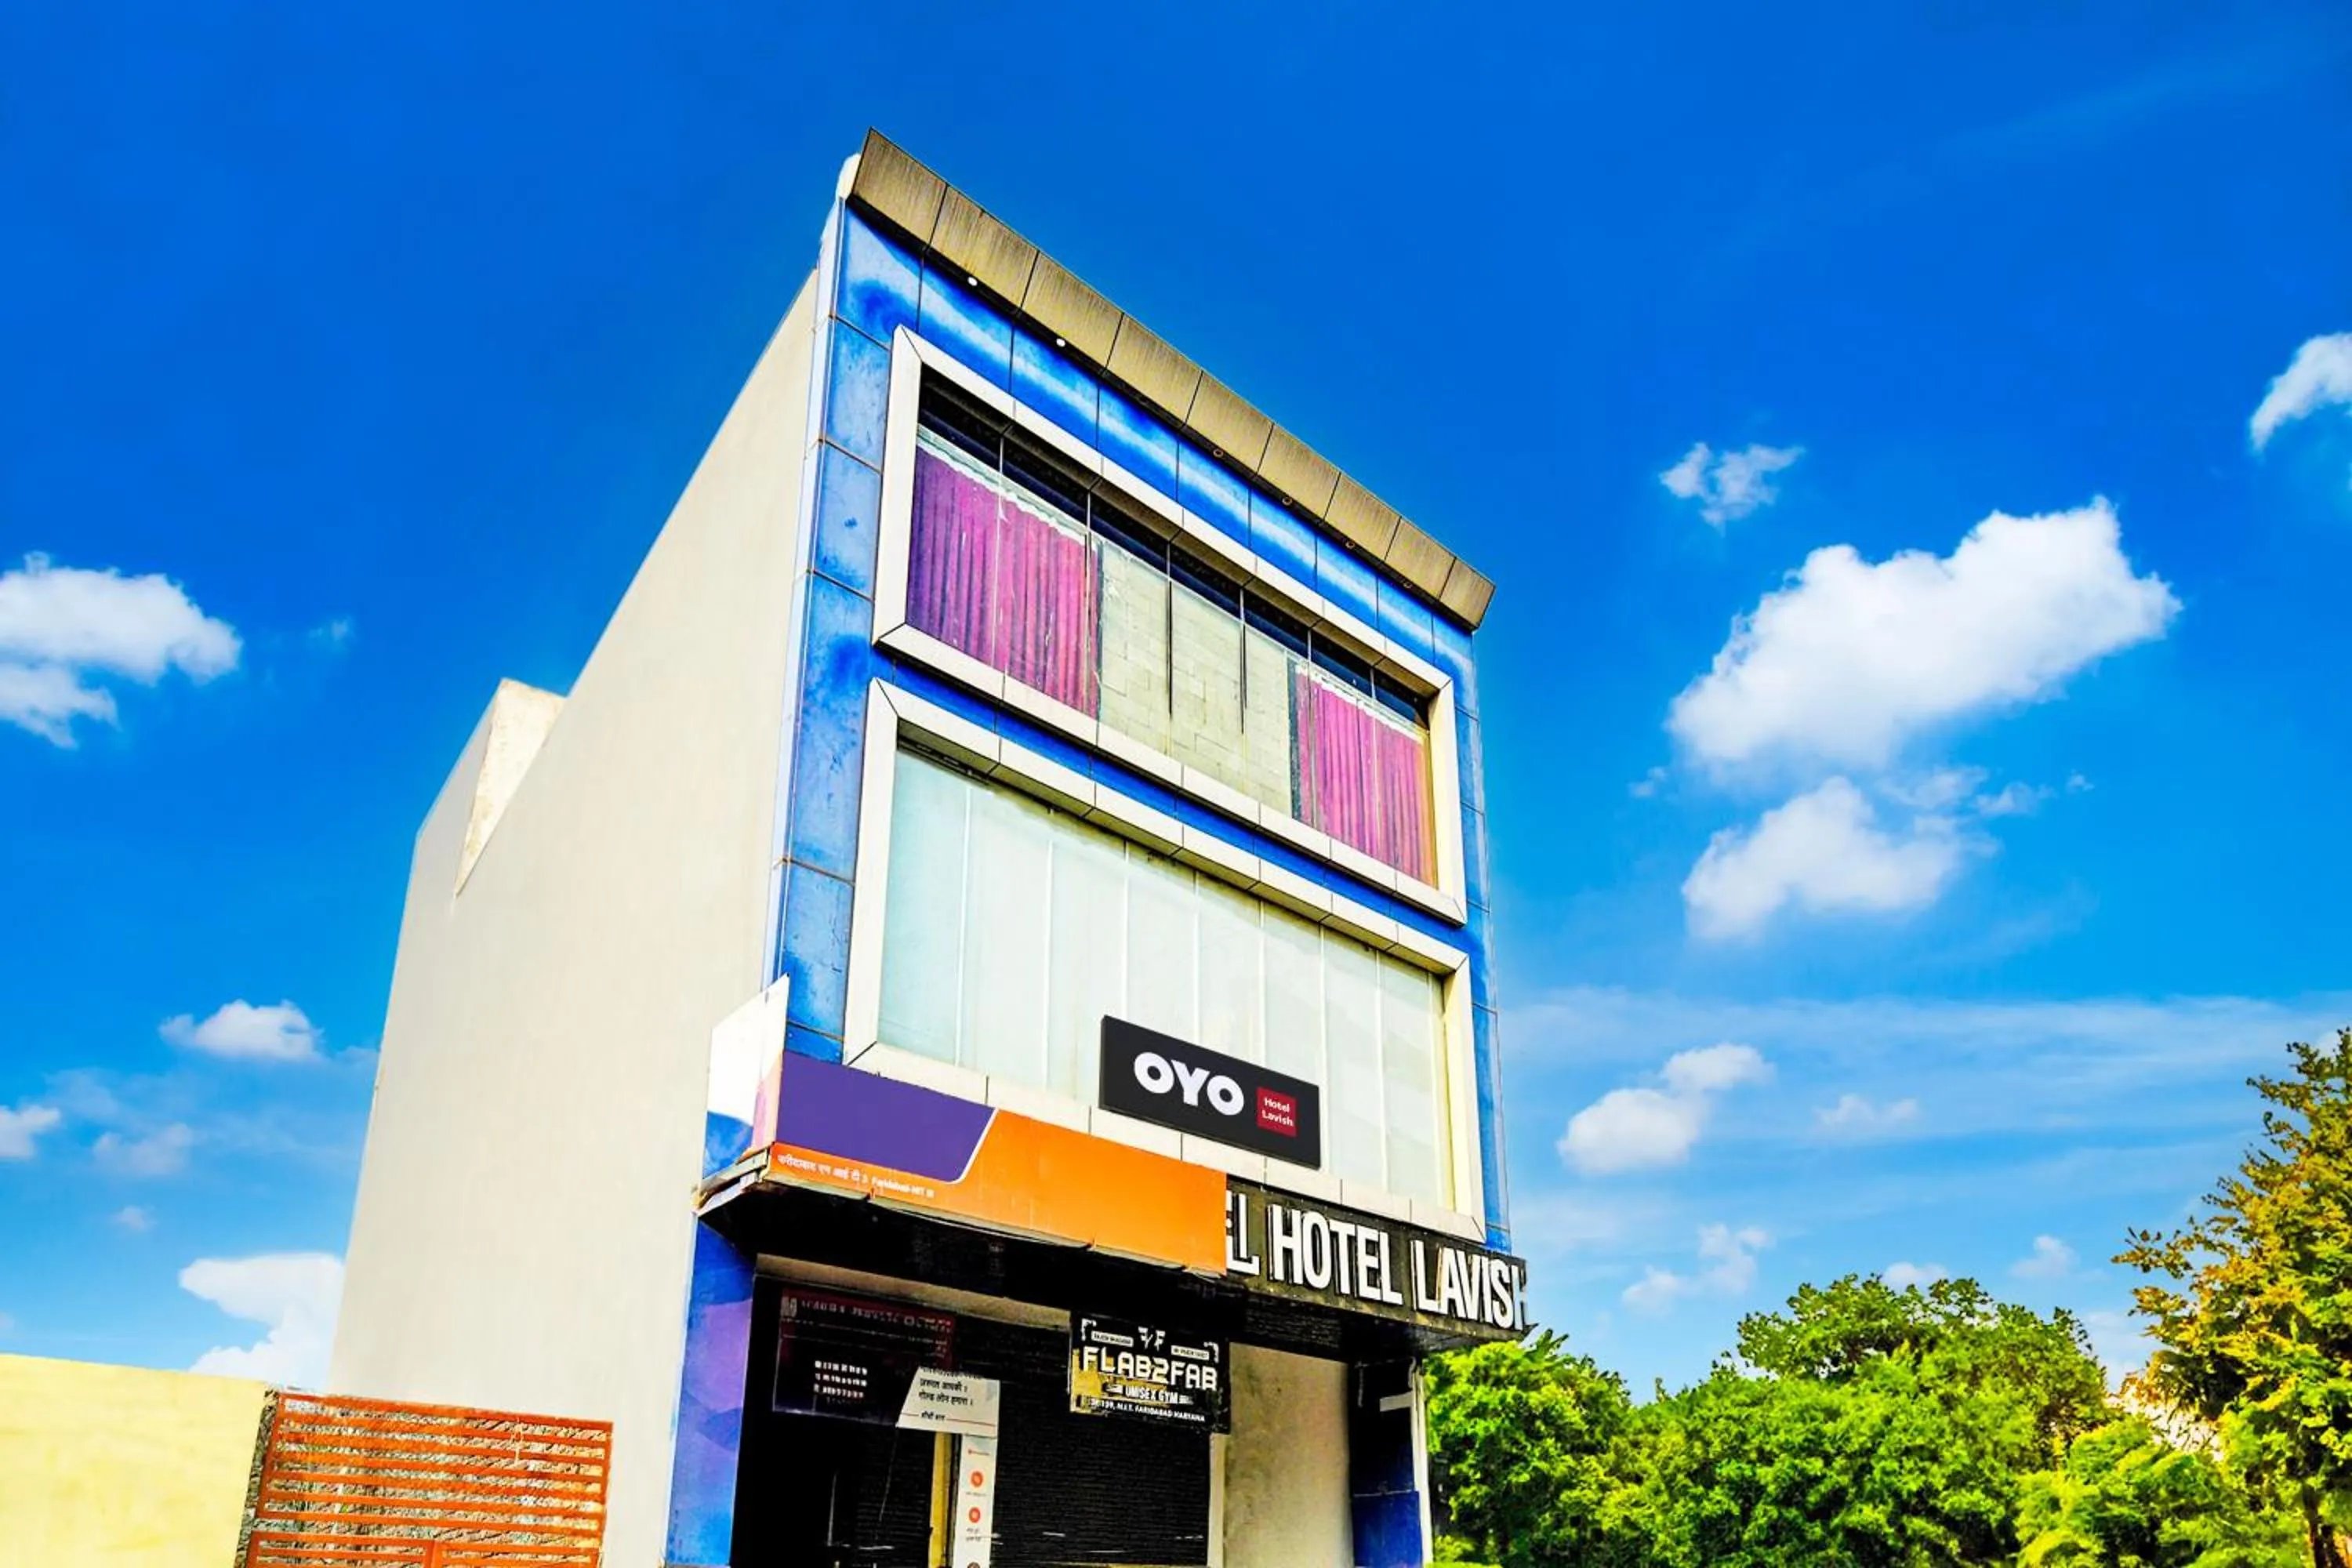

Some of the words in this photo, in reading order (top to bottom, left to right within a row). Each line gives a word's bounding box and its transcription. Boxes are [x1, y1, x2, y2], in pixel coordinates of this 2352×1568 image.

[1134, 1051, 1245, 1116] OYO
[1264, 1097, 1290, 1112] Hotel
[1261, 1109, 1294, 1127] Lavish
[1268, 1204, 1404, 1306] HOTEL
[1083, 1345, 1218, 1392] FLAB2FAB
[1125, 1384, 1156, 1401] UNISEX
[1158, 1389, 1178, 1405] GYM
[1134, 1404, 1173, 1417] FARIDABAD
